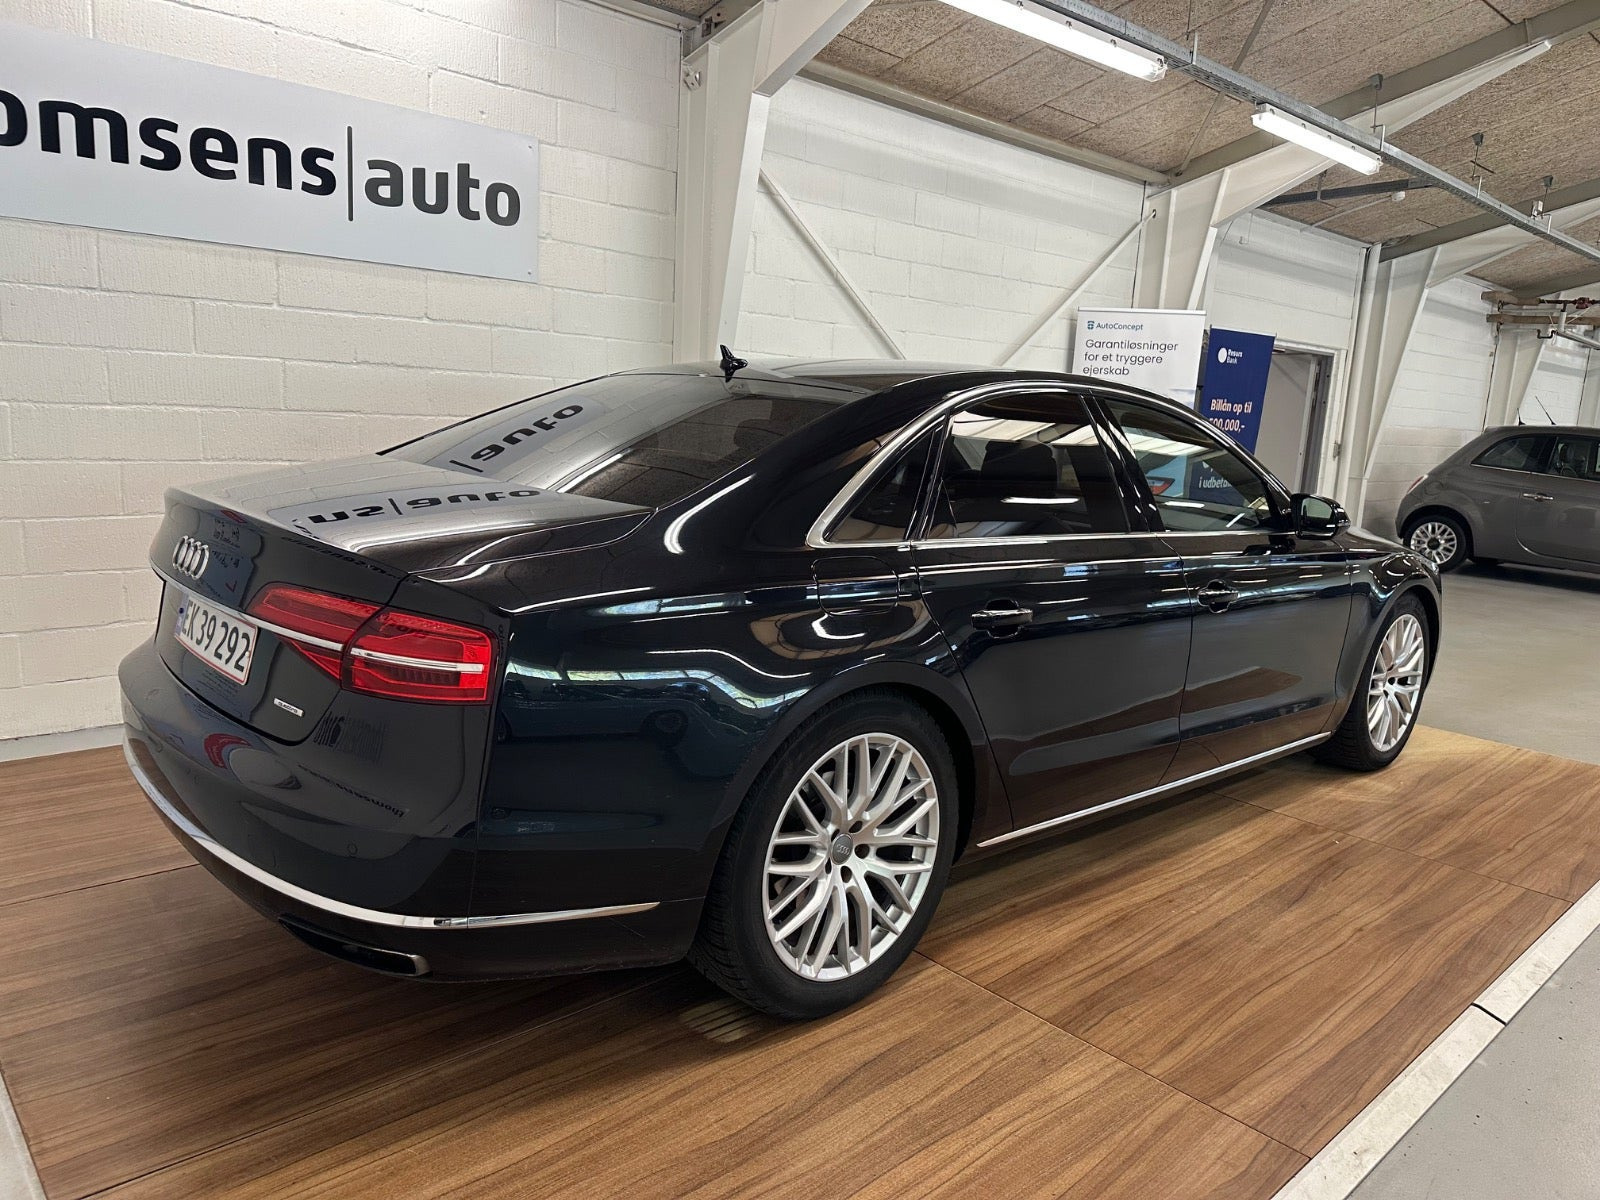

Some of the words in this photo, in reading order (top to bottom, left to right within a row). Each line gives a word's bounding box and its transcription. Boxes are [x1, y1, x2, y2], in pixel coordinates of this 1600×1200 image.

[364, 158, 521, 227] auto
[1095, 321, 1144, 332] AutoConcept
[1085, 338, 1179, 354] Garantiløsninger
[1084, 351, 1099, 362] for
[1101, 352, 1113, 363] et
[1115, 353, 1163, 366] tryggere
[1082, 364, 1130, 377] ejerskab
[1210, 398, 1232, 412] Billån
[1232, 403, 1243, 416] op
[1243, 401, 1253, 414] til
[1209, 417, 1246, 433] 00.000,-
[181, 599, 201, 641] EK
[195, 609, 217, 652] 39
[213, 620, 251, 673] 292
